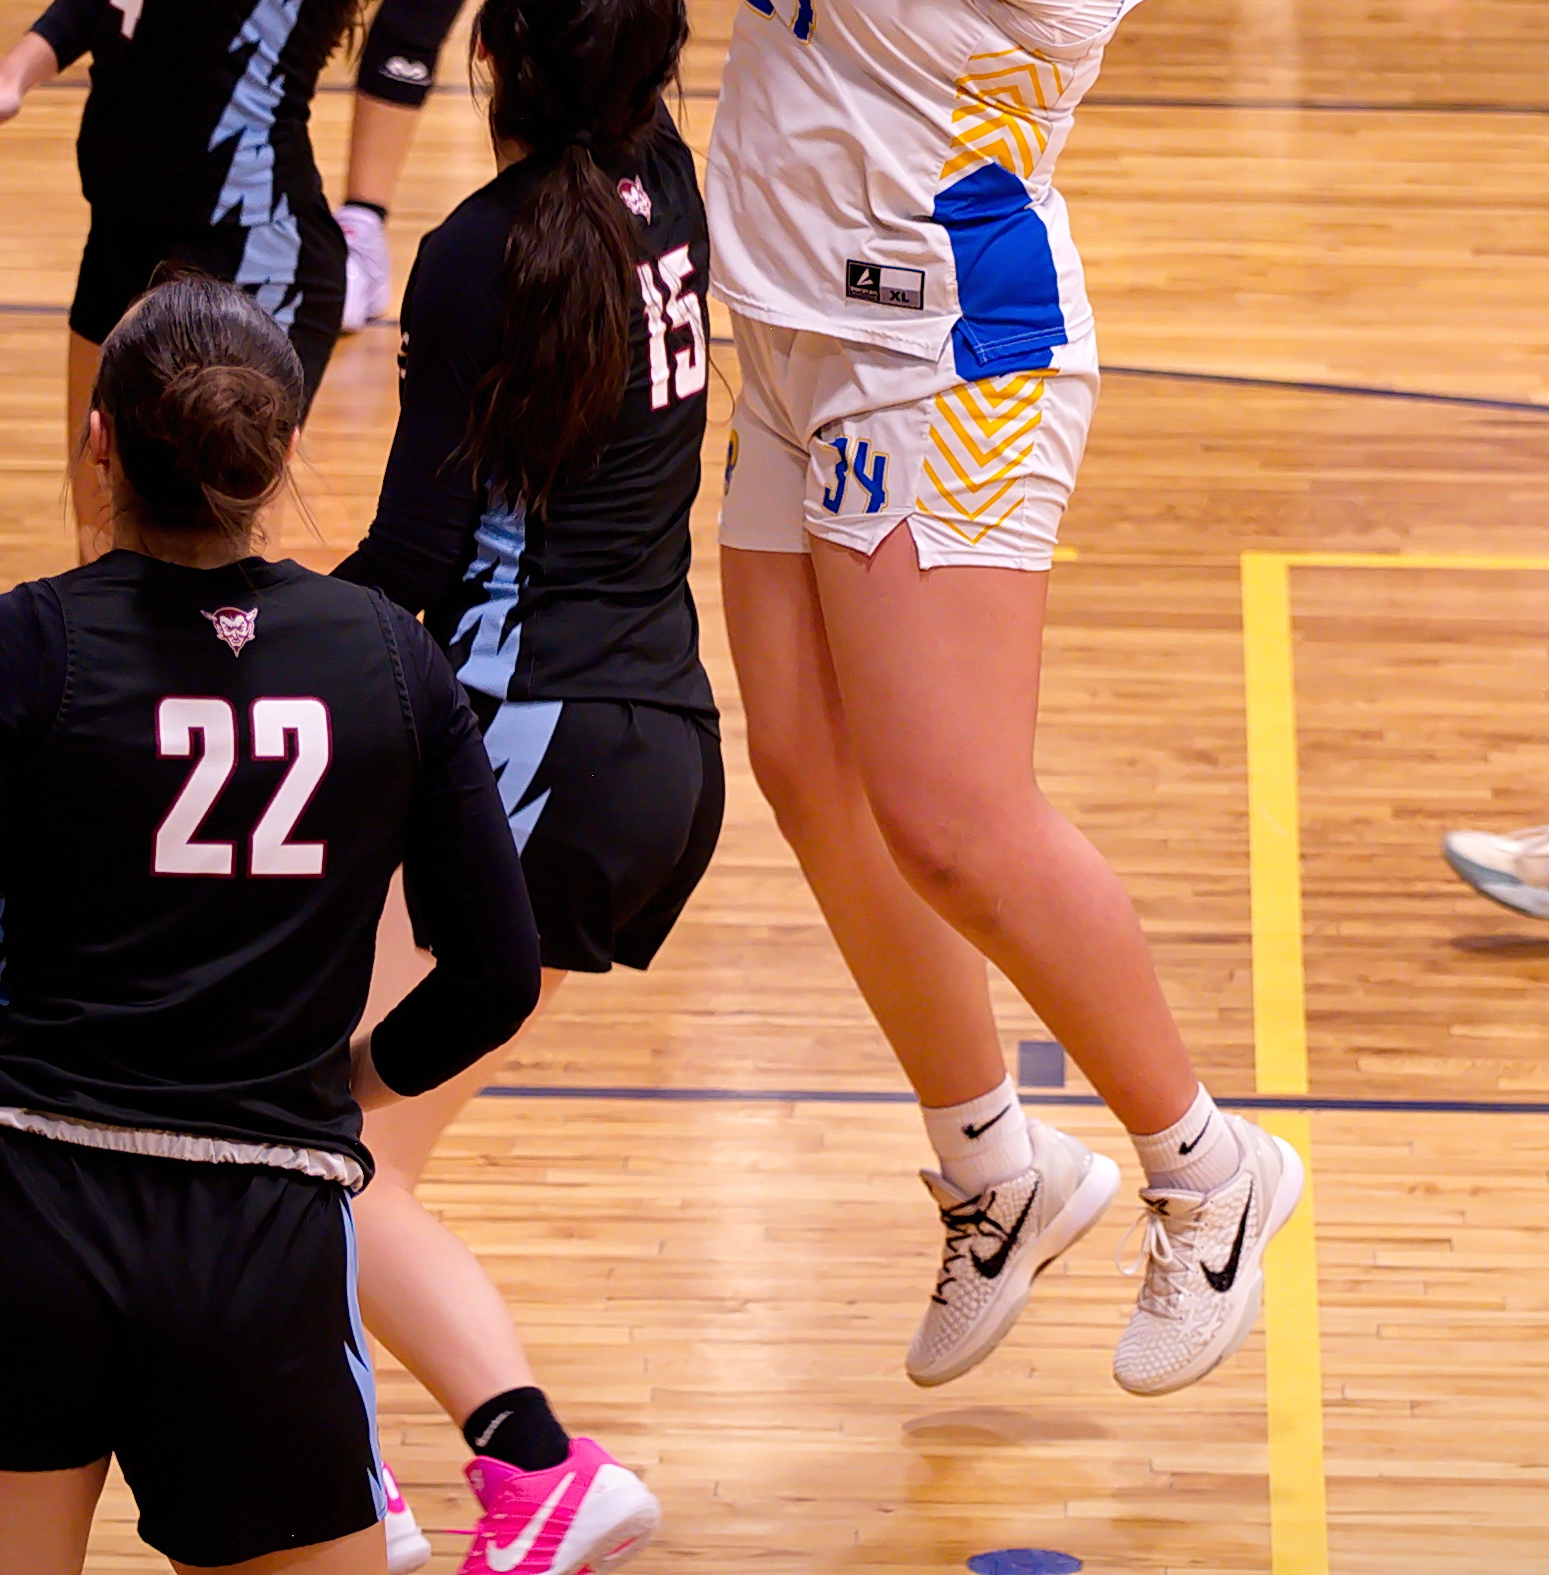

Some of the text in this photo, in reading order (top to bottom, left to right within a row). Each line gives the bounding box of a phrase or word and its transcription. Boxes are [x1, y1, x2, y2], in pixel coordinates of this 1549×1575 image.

[637, 241, 707, 412] 15
[889, 289, 910, 304] XL
[151, 695, 333, 878] 22
